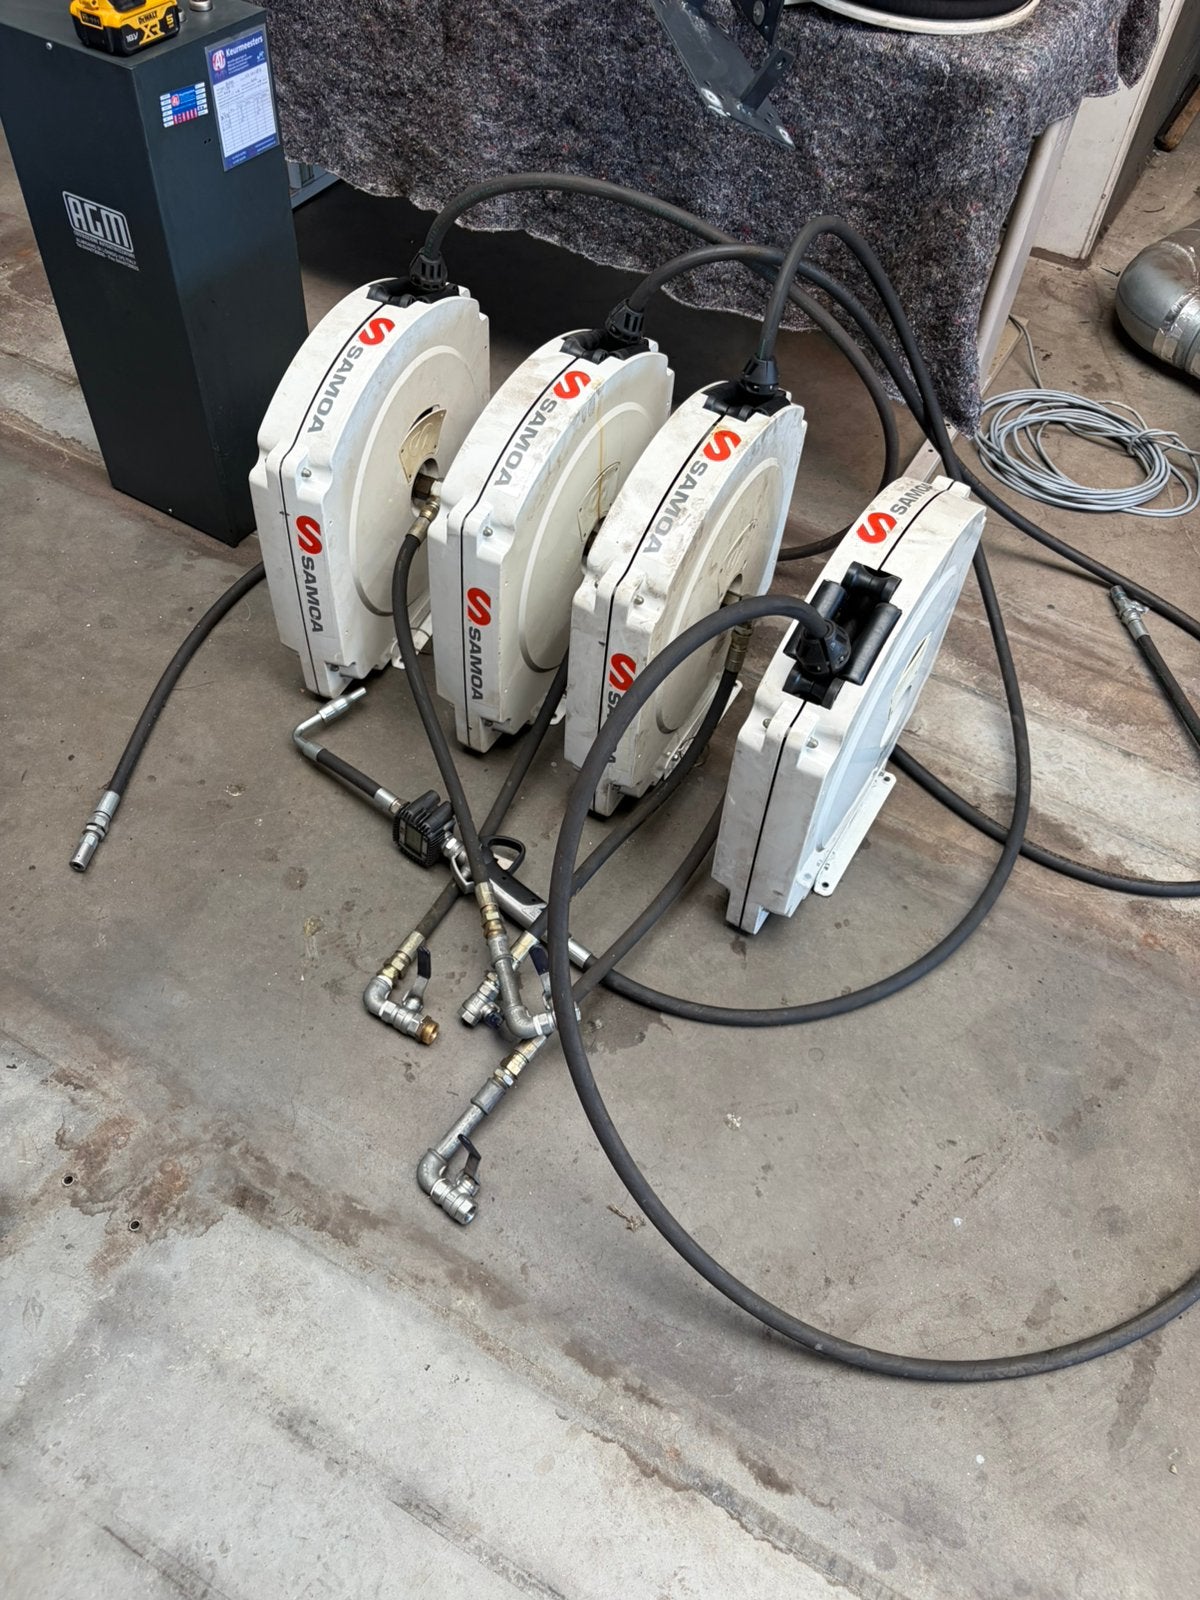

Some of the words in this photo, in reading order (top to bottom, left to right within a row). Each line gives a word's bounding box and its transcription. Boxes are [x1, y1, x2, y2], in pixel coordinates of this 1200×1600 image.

[67, 196, 130, 249] AGM
[307, 345, 364, 433] SAMOA
[493, 398, 558, 486] SAMOA
[642, 460, 708, 553] SAMOA
[301, 555, 324, 632] SAMOA
[468, 626, 484, 700] SAMOA
